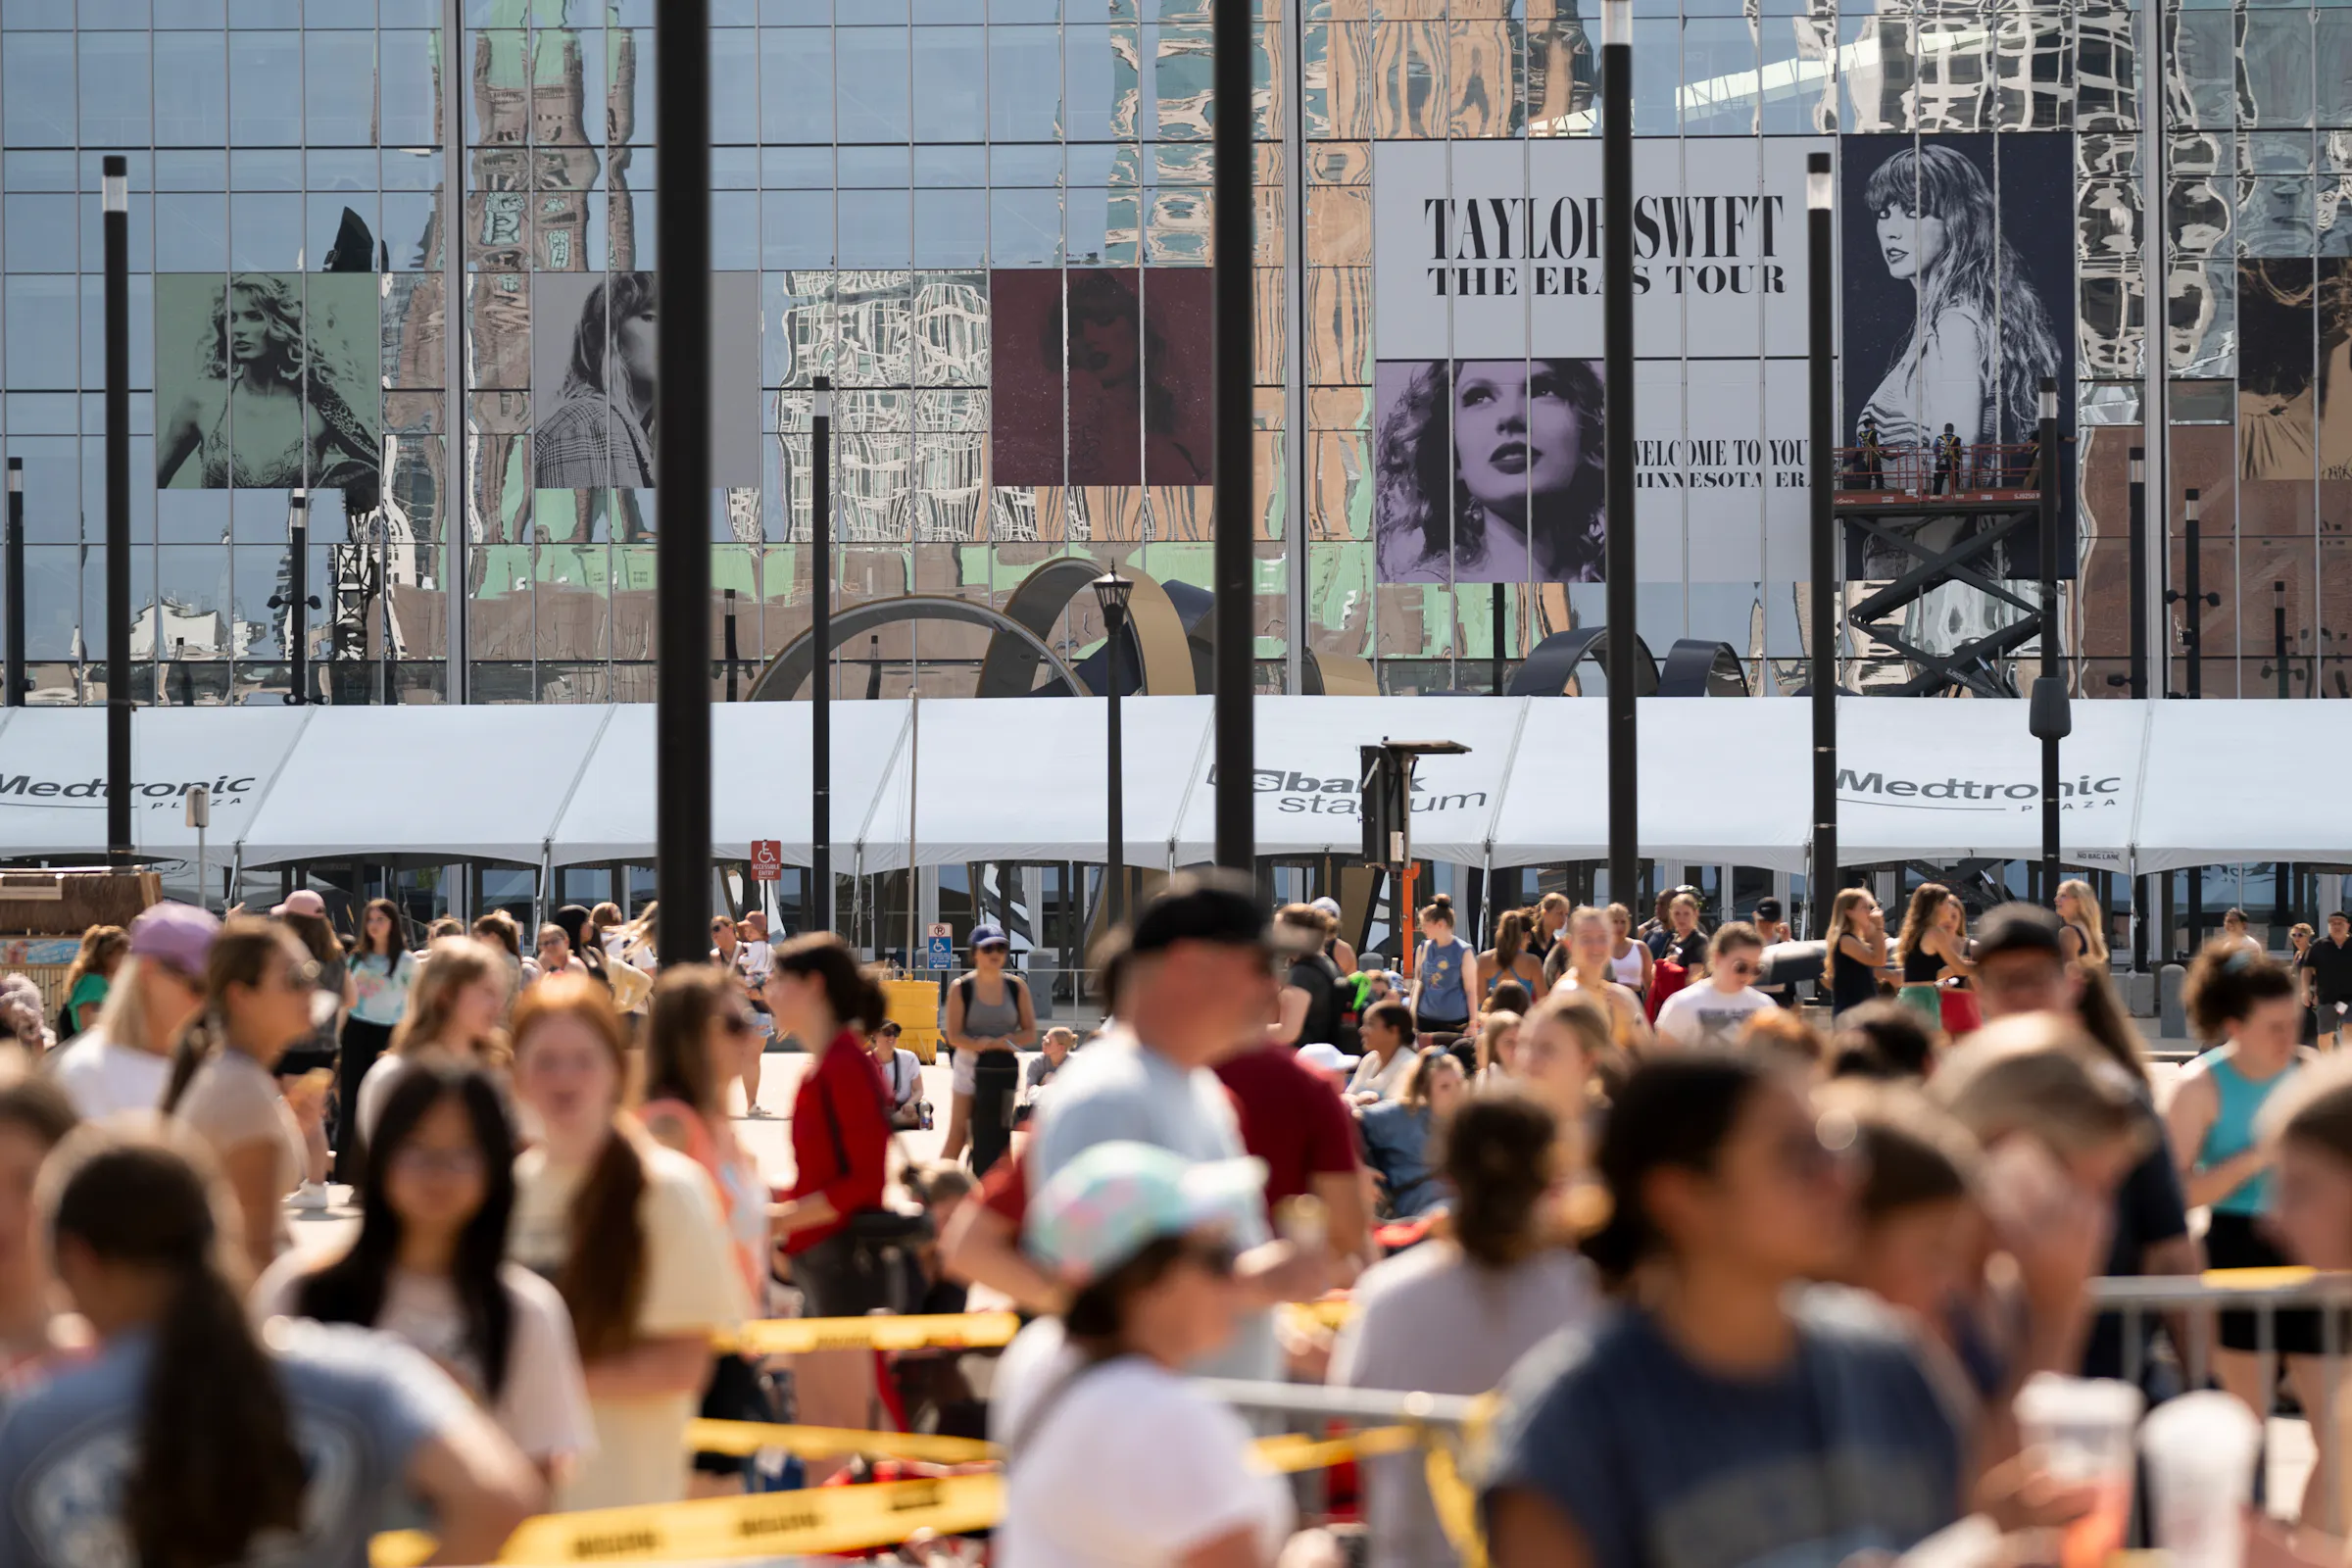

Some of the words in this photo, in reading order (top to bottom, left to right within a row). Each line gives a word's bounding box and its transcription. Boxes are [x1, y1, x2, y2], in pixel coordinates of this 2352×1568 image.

[1633, 194, 1784, 261] SWIFT
[1427, 267, 1517, 296] THE
[1666, 264, 1787, 295] TOUR
[1734, 438, 1761, 466] TO
[1776, 471, 1811, 488] ER
[151, 798, 241, 809] PLZA
[1278, 792, 1487, 814] staum
[2021, 799, 2116, 811] PAZA
